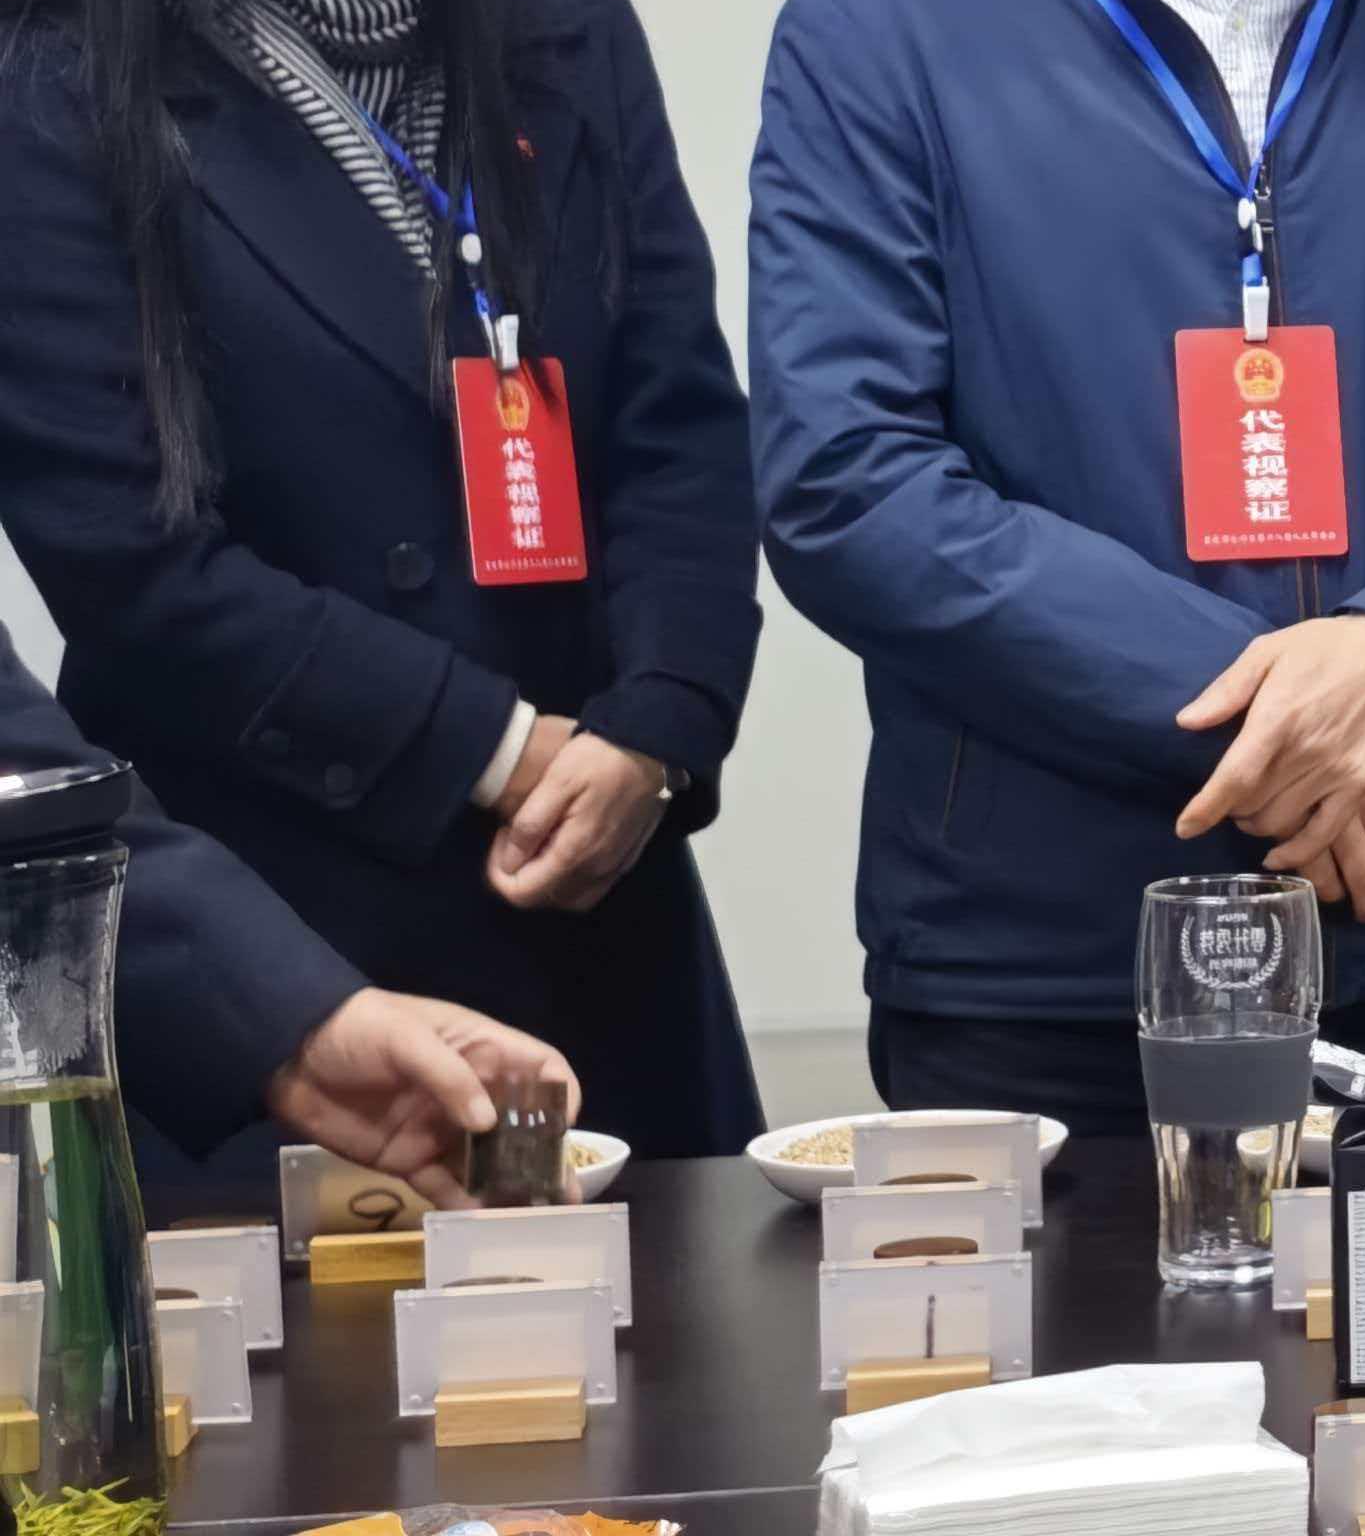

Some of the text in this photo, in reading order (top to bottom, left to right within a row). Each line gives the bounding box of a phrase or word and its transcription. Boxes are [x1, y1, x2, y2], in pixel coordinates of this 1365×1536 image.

[1239, 409, 1292, 522] 代表视察证
